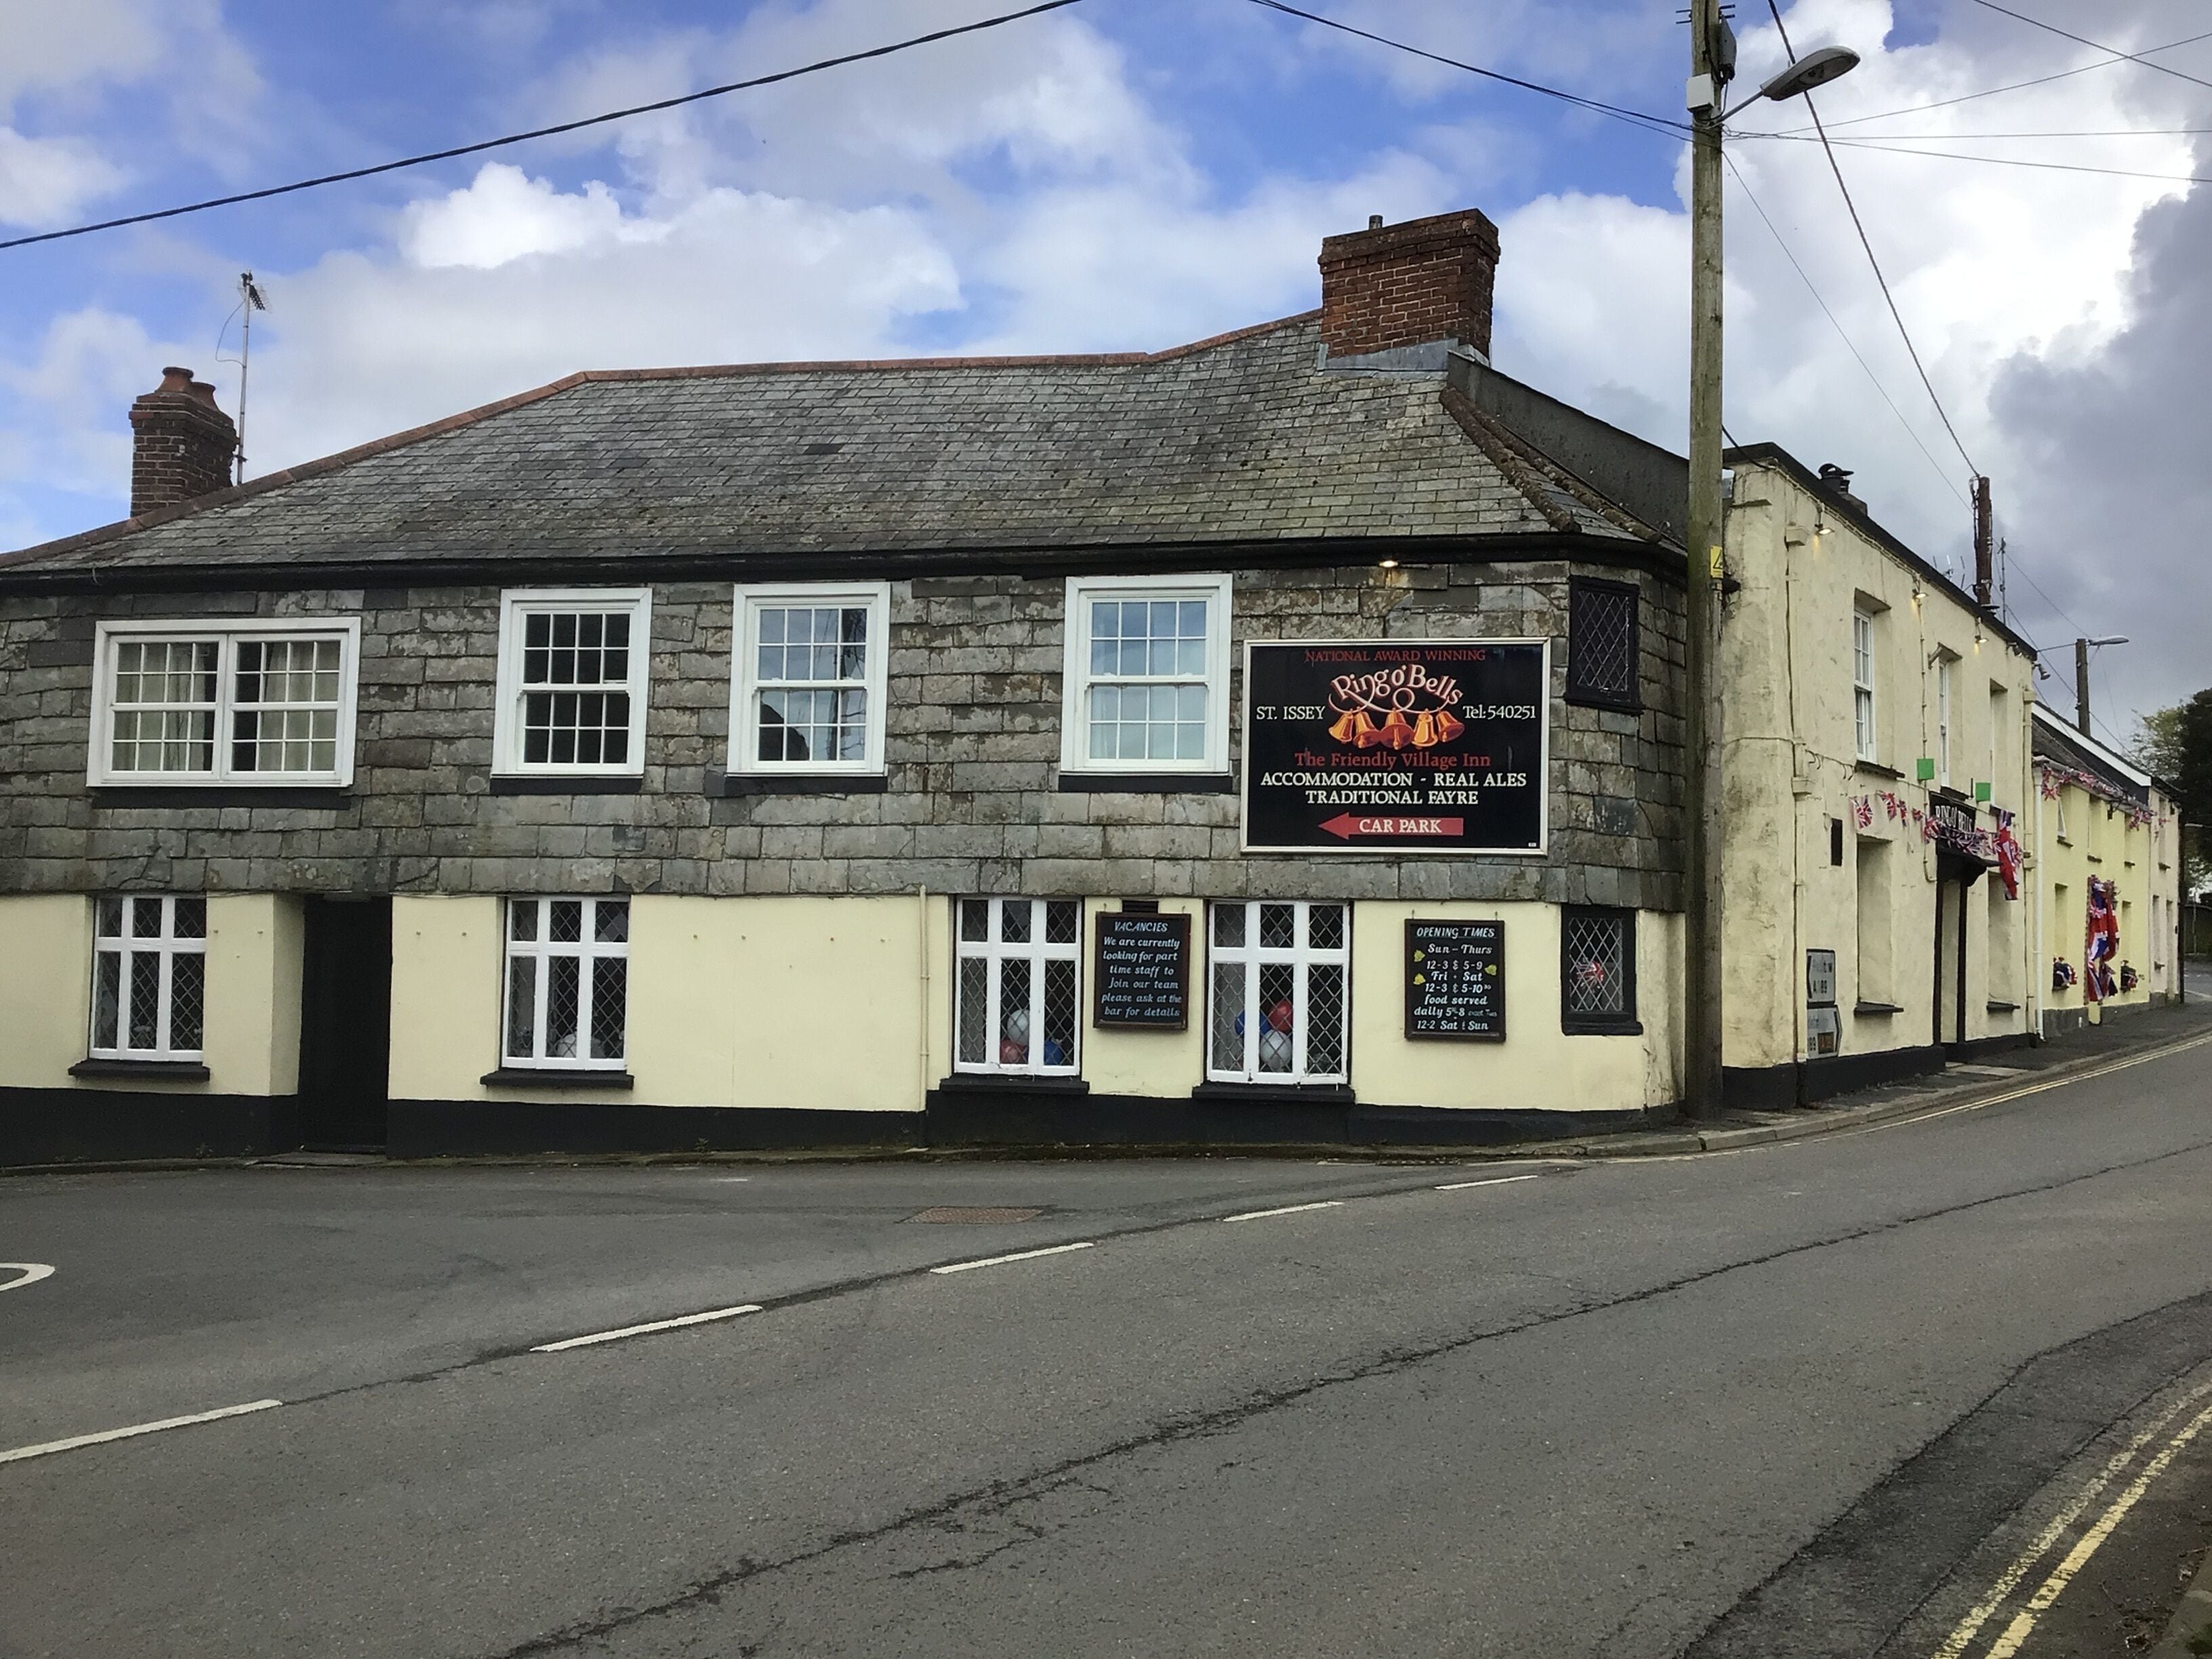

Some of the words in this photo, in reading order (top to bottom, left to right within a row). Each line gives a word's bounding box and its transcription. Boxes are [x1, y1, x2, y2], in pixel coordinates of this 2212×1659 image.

[1305, 651, 1370, 662] NATIONAL
[1374, 651, 1420, 661] AWARD
[1425, 649, 1486, 661] WINNING
[1256, 706, 1278, 720] ST.
[1282, 706, 1326, 720] ISSEY
[1294, 752, 1325, 767] The
[1330, 752, 1397, 771] Friendly
[1401, 752, 1457, 771] Village
[1462, 753, 1491, 767] Inn
[1260, 773, 1414, 787] ACCOMMODATION
[1433, 773, 1479, 787] REAL
[1483, 773, 1528, 787] ALES
[1305, 790, 1423, 805] TRADITIONAL
[1427, 791, 1479, 805] FAYRE
[1359, 819, 1395, 833] CAR
[1398, 819, 1442, 833] PARK
[1114, 922, 1168, 932] VACANCIES
[1416, 927, 1459, 939] OPENING
[1462, 928, 1495, 938] TIMES
[1103, 937, 1116, 946] We
[1137, 939, 1181, 950] currently
[1427, 943, 1451, 954] Sun
[1460, 944, 1493, 954] Thurs
[1103, 951, 1137, 962] looking
[1139, 951, 1153, 963] for
[1155, 952, 1178, 963] part
[1109, 965, 1131, 975] time
[1134, 965, 1161, 978] staff
[1164, 966, 1174, 976] to
[1431, 971, 1448, 981] Fri
[1462, 971, 1483, 982] Sat
[1133, 981, 1150, 989] our
[1154, 981, 1179, 989] team
[1101, 993, 1132, 1003] please
[1136, 994, 1154, 1003] ask
[1157, 995, 1166, 1003] at
[1168, 994, 1182, 1004] the
[1424, 994, 1449, 1005] food
[1451, 996, 1488, 1005] served
[1104, 1006, 1122, 1016] bar
[1125, 1006, 1140, 1019] for
[1144, 1007, 1181, 1017] details
[1414, 1006, 1443, 1019] daily
[1440, 1020, 1458, 1030] Sat
[1467, 1020, 1489, 1031] Sun
